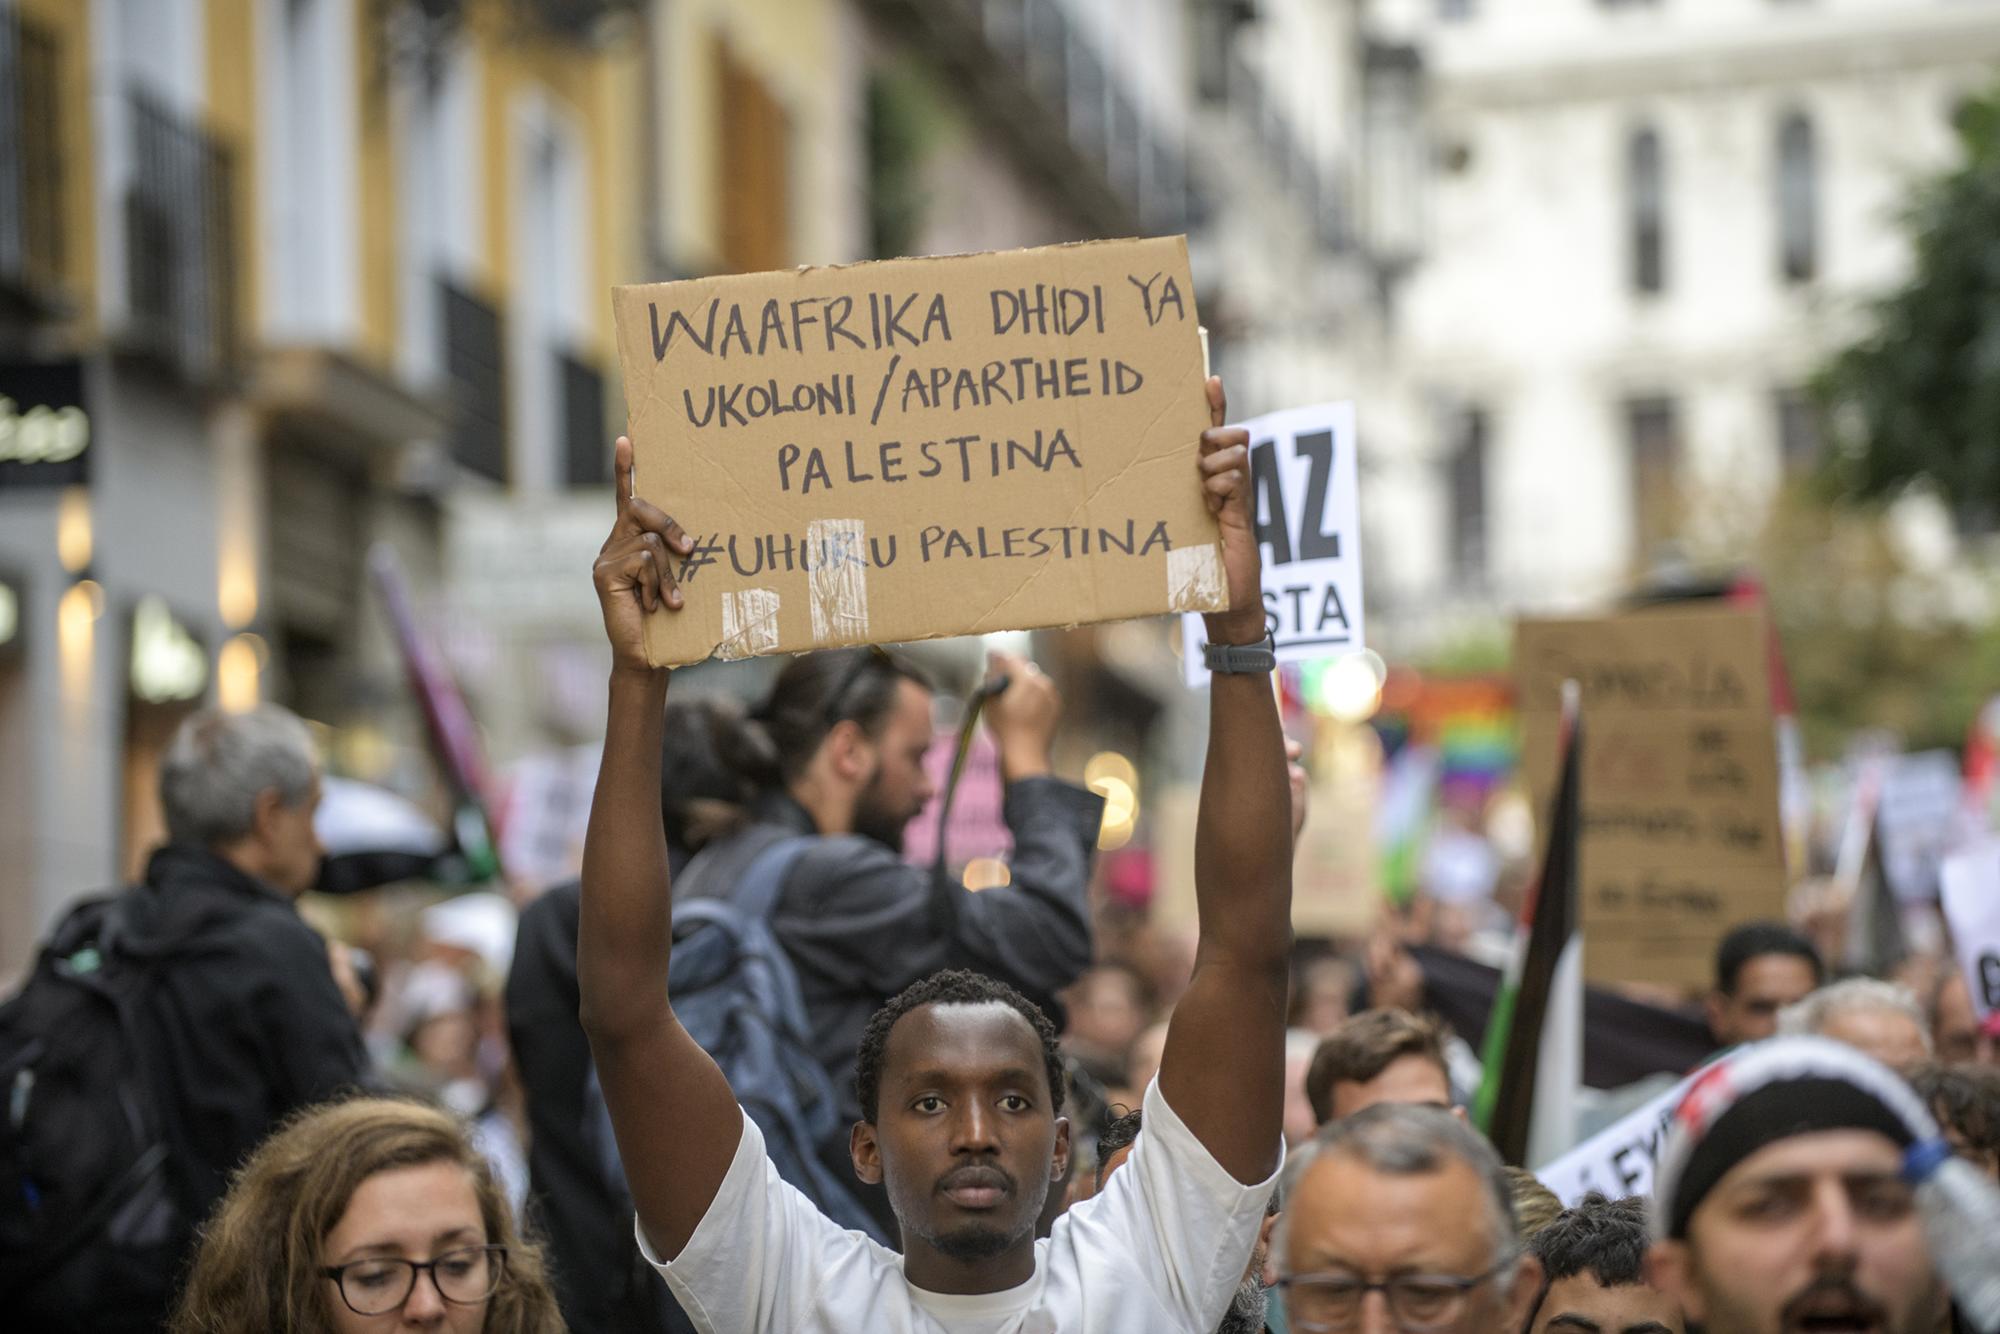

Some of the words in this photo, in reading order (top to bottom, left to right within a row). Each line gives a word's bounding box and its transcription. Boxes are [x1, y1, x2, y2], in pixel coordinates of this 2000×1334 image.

[649, 292, 952, 362] WAAFRIKA
[991, 283, 1104, 336] DHIDI
[1128, 271, 1185, 327] YA
[778, 429, 1082, 494] PALESTINA
[919, 519, 1172, 563] PALESTINA
